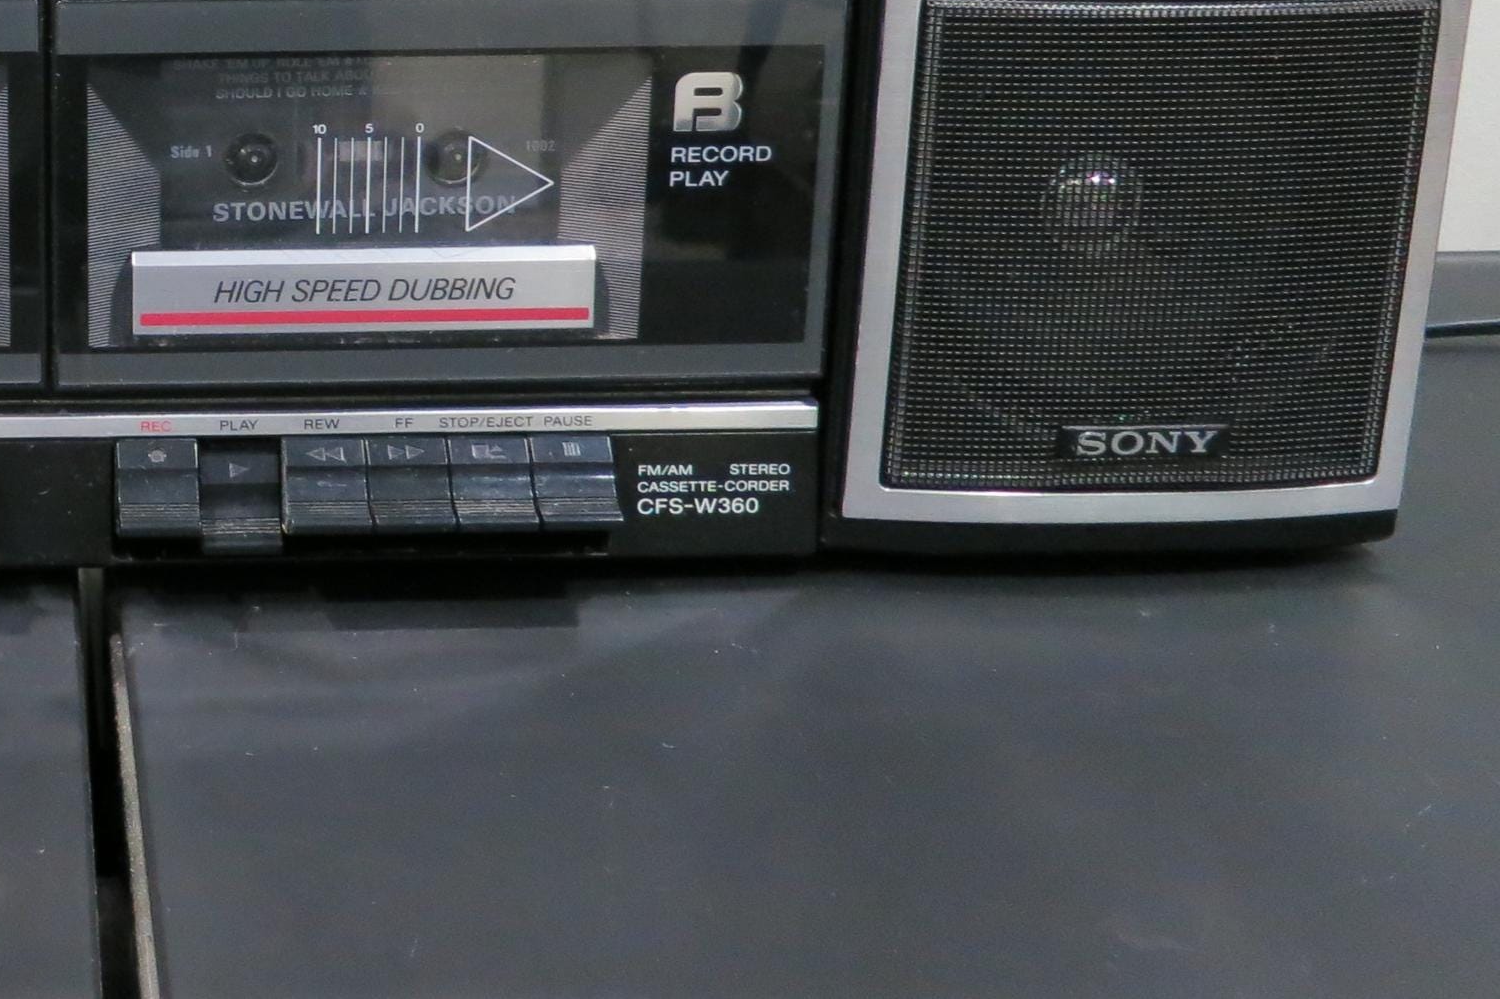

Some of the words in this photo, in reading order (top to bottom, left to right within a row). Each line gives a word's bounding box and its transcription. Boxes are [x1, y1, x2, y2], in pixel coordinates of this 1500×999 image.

[216, 87, 273, 99] SHOULD
[284, 86, 307, 98] GO
[311, 84, 352, 97] HOME
[673, 72, 743, 131] B
[312, 123, 327, 135] 10
[365, 123, 374, 134] 5
[415, 122, 425, 134] 0
[170, 145, 200, 159] Side
[205, 145, 212, 158] 1
[671, 145, 772, 163] RECORD
[669, 170, 729, 187] PLAY
[212, 199, 376, 222] STONEWALL
[385, 195, 517, 218] JACKSON
[214, 280, 285, 303] HIGH
[291, 278, 381, 302] SPEED
[388, 277, 516, 301] DUBBING
[140, 420, 171, 432] REC
[219, 419, 258, 431] PLAY
[304, 418, 340, 430] REW
[395, 418, 414, 429] FF
[439, 416, 534, 429] STOP/EJECT
[543, 415, 594, 427] PAUSE
[1076, 430, 1219, 456] SONY
[637, 465, 693, 476] FM/AM
[729, 463, 791, 475] STEREO
[637, 480, 790, 493] CASSETTE-CORDER
[637, 498, 759, 515] CFS-W360
